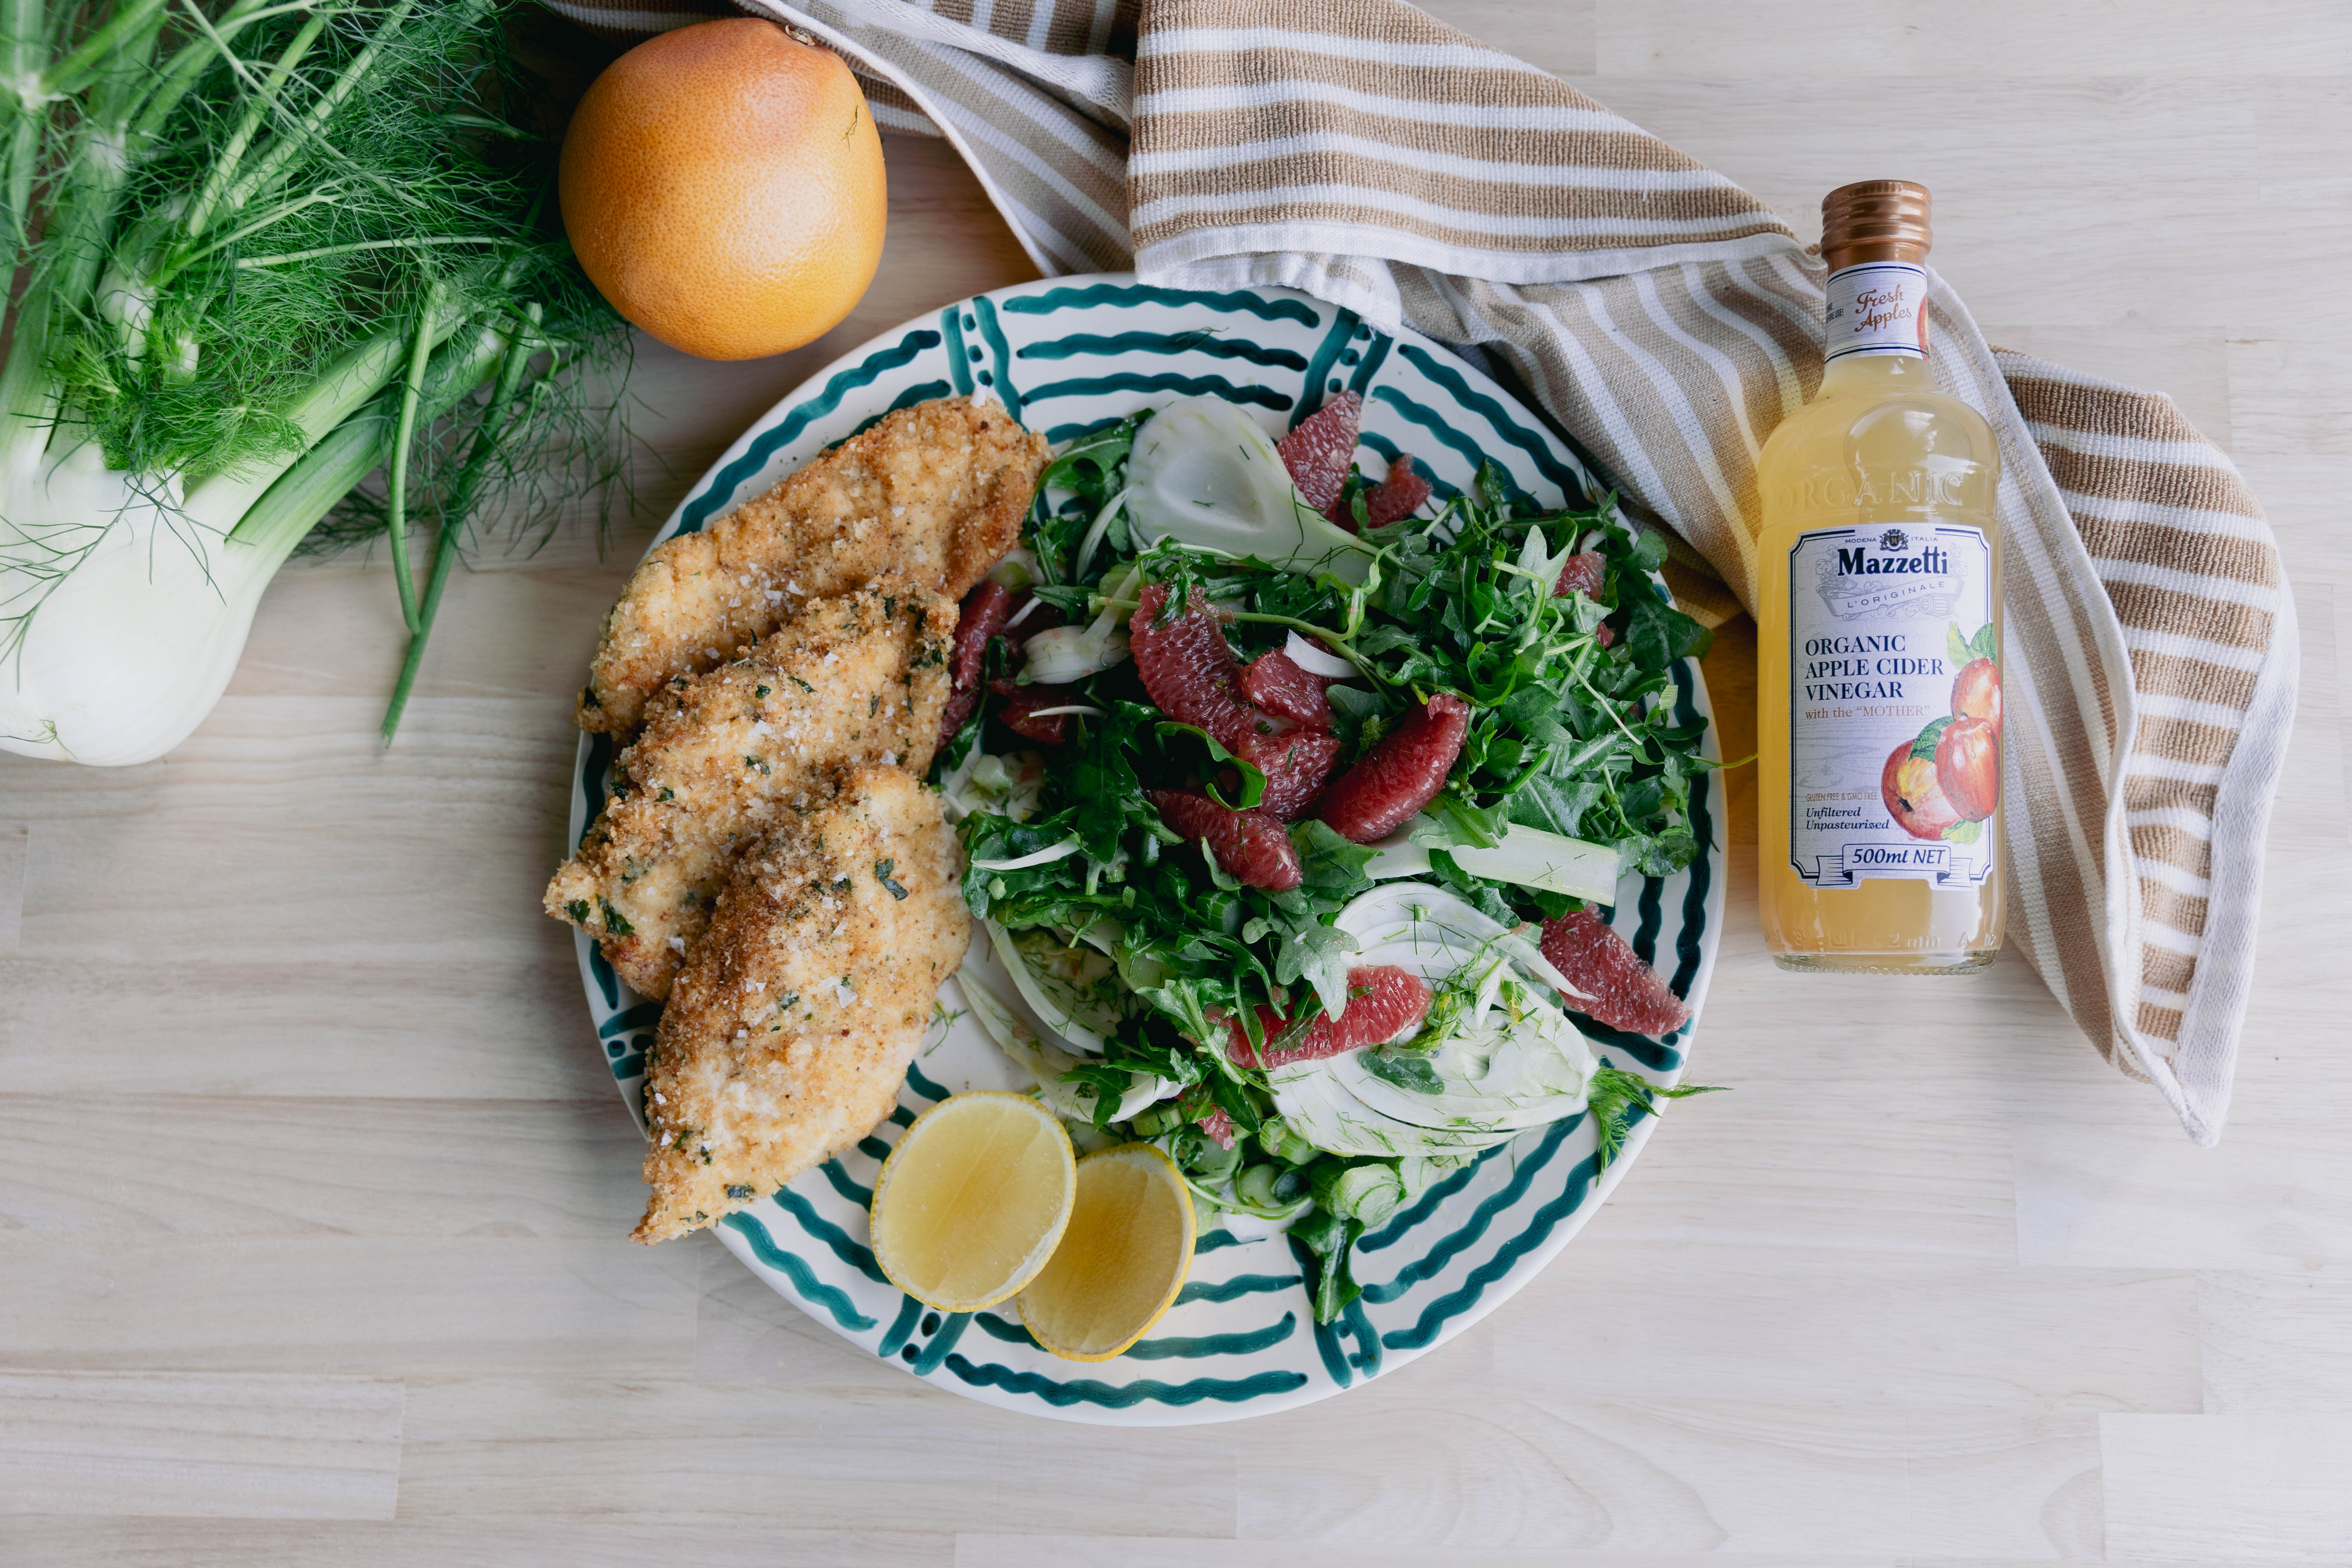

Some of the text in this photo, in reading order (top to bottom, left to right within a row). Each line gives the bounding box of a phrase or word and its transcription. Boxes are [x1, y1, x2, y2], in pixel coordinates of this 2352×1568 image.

[1855, 284, 1904, 314] Fresh
[1834, 308, 1844, 318] USE!
[1854, 303, 1911, 332] Apples
[1778, 471, 1964, 512] ORGANIC
[1837, 546, 1948, 576] Mazzetti
[1847, 582, 1945, 608] L'ORIGINALE
[1805, 635, 1905, 656] ORGANIC
[1805, 658, 1945, 679] APPLE CIDER
[1805, 681, 1904, 701] VINEGAR
[1805, 708, 1828, 719] with
[1833, 707, 1852, 717] the
[1806, 793, 1825, 802] GLUTEN
[1827, 793, 1839, 801] FREE
[1806, 806, 1861, 819] Unfiltered
[1806, 819, 1890, 832] Unpasteurized
[1852, 848, 1946, 864] 500ml NET
